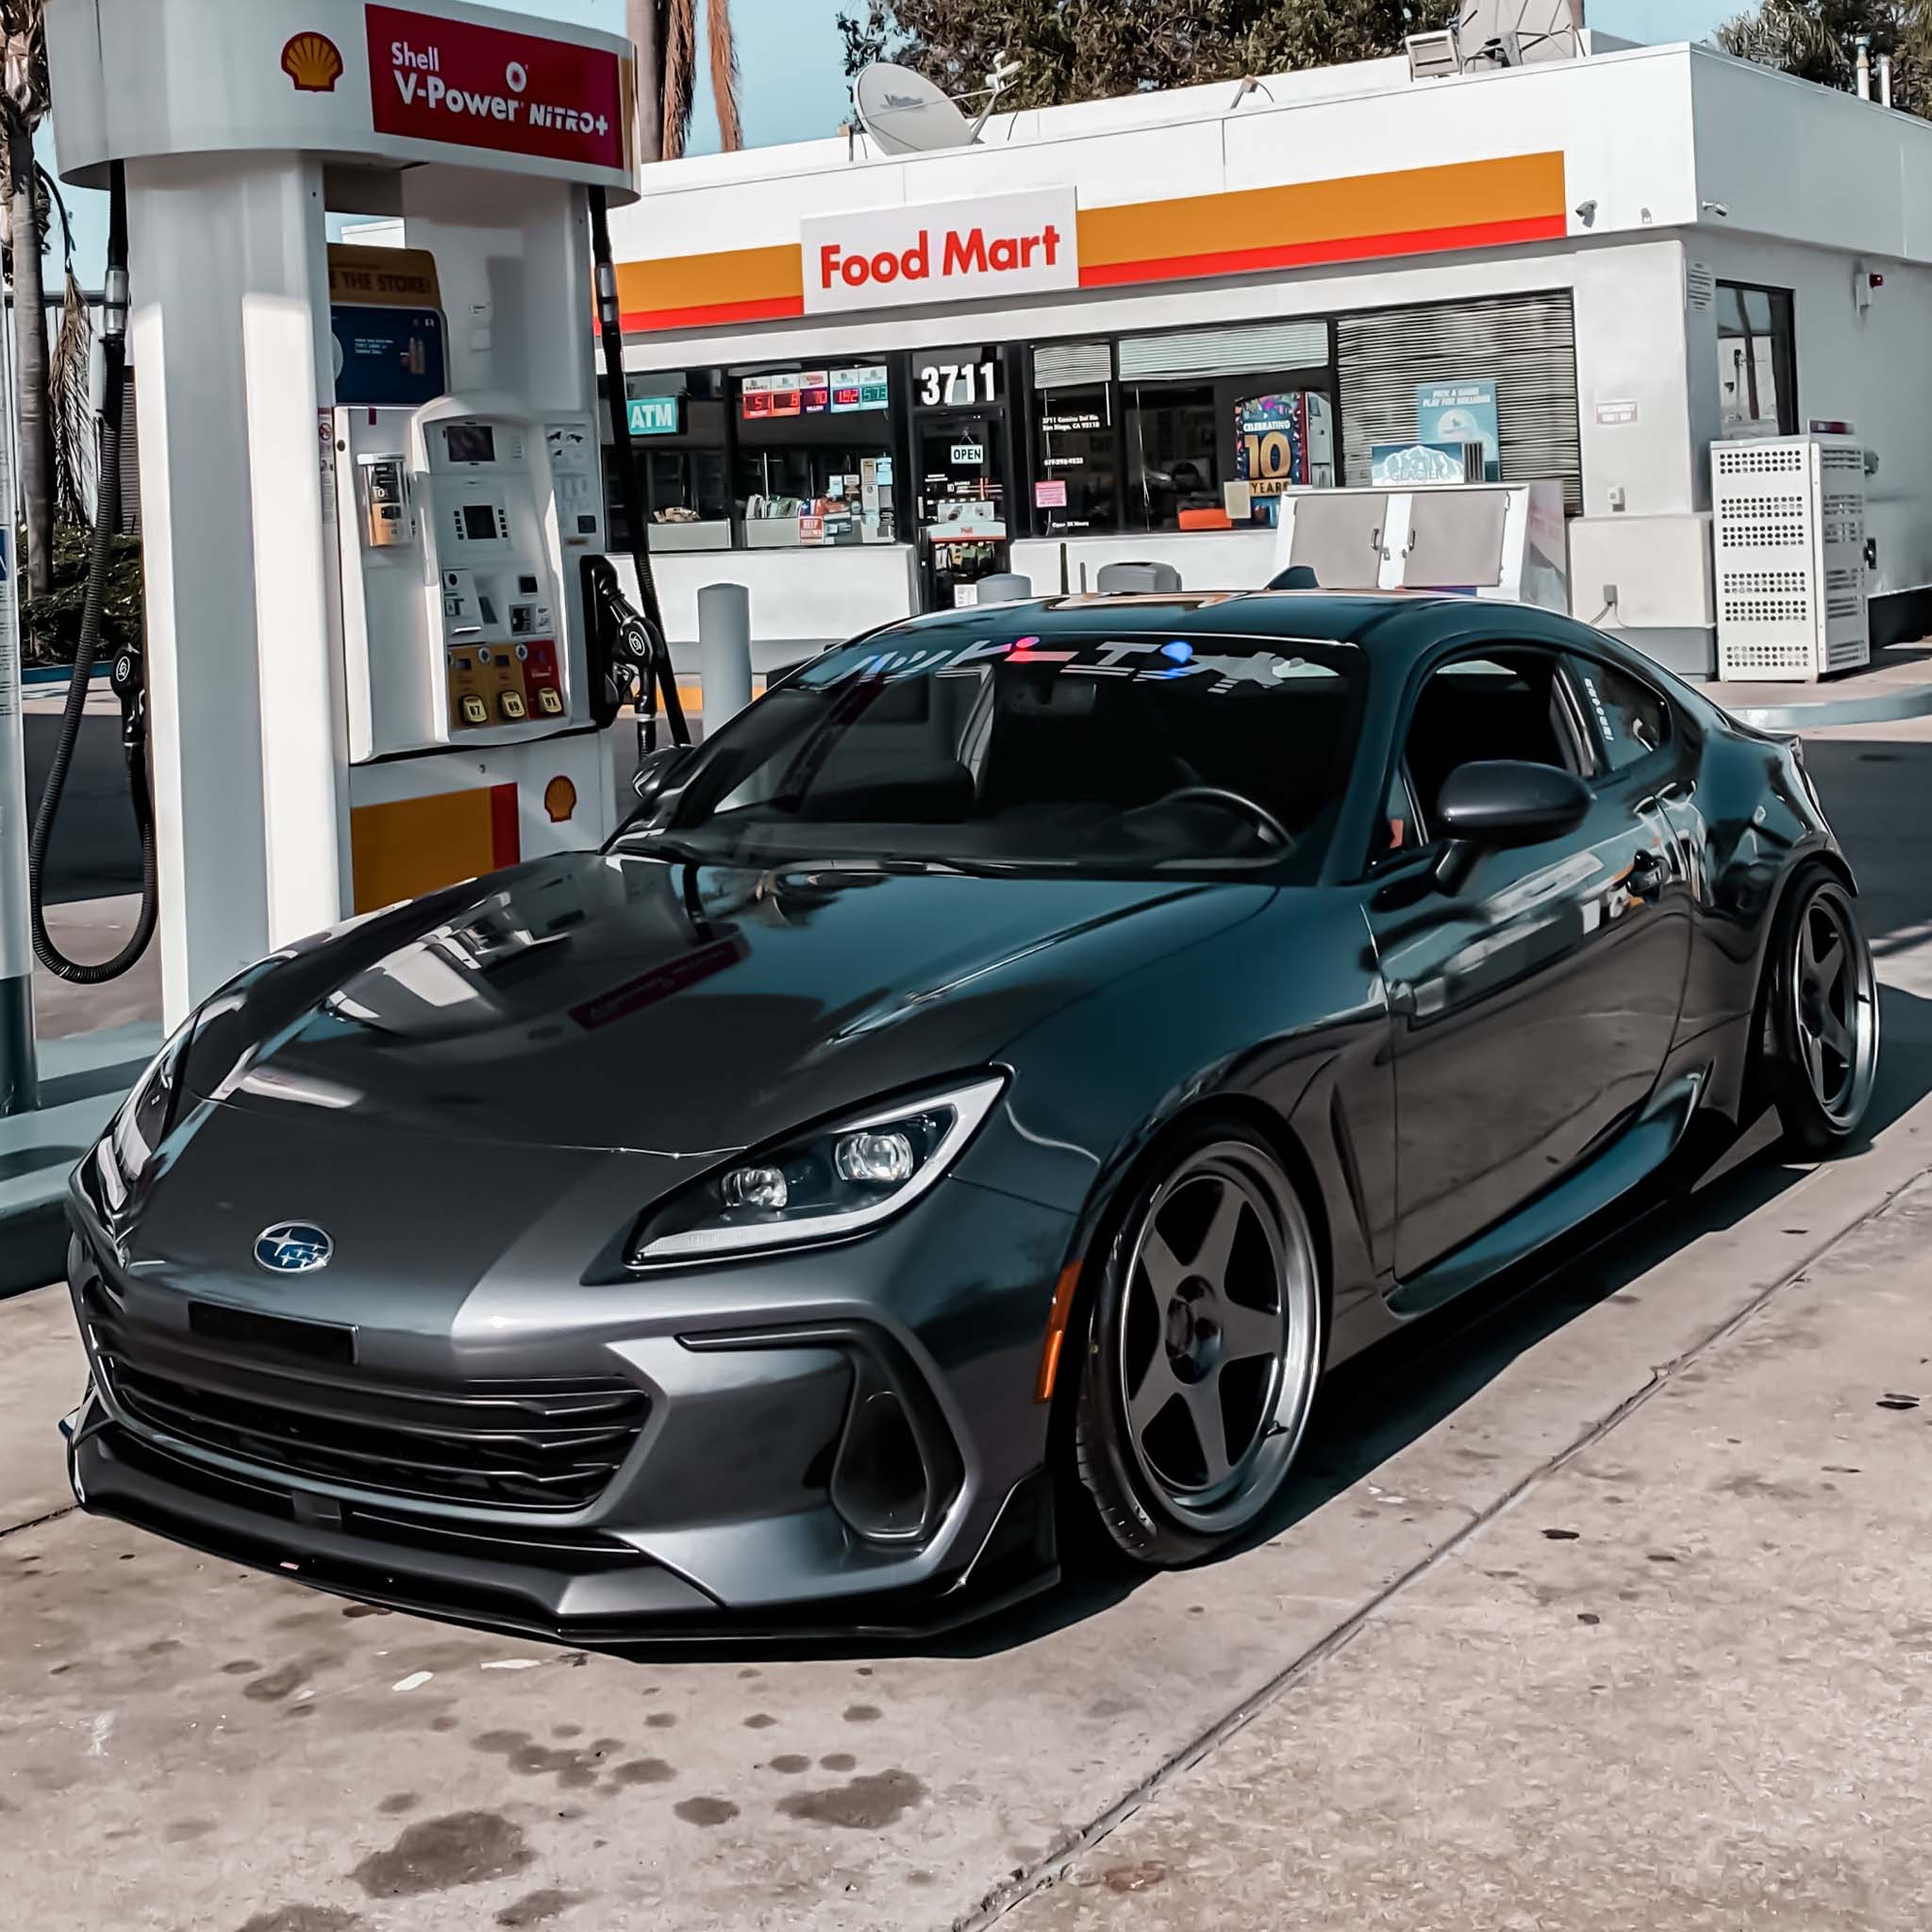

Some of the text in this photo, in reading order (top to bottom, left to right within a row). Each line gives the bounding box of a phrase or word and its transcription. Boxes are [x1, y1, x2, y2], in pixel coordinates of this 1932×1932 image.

[391, 42, 440, 72] Shell
[393, 70, 518, 121] V-Power
[821, 225, 1060, 289] Food Mart
[921, 361, 995, 406] 3711
[630, 403, 673, 428] ATM
[1242, 420, 1291, 432] CELEBRATING
[953, 448, 981, 460] OPEN
[1244, 430, 1291, 478] 10
